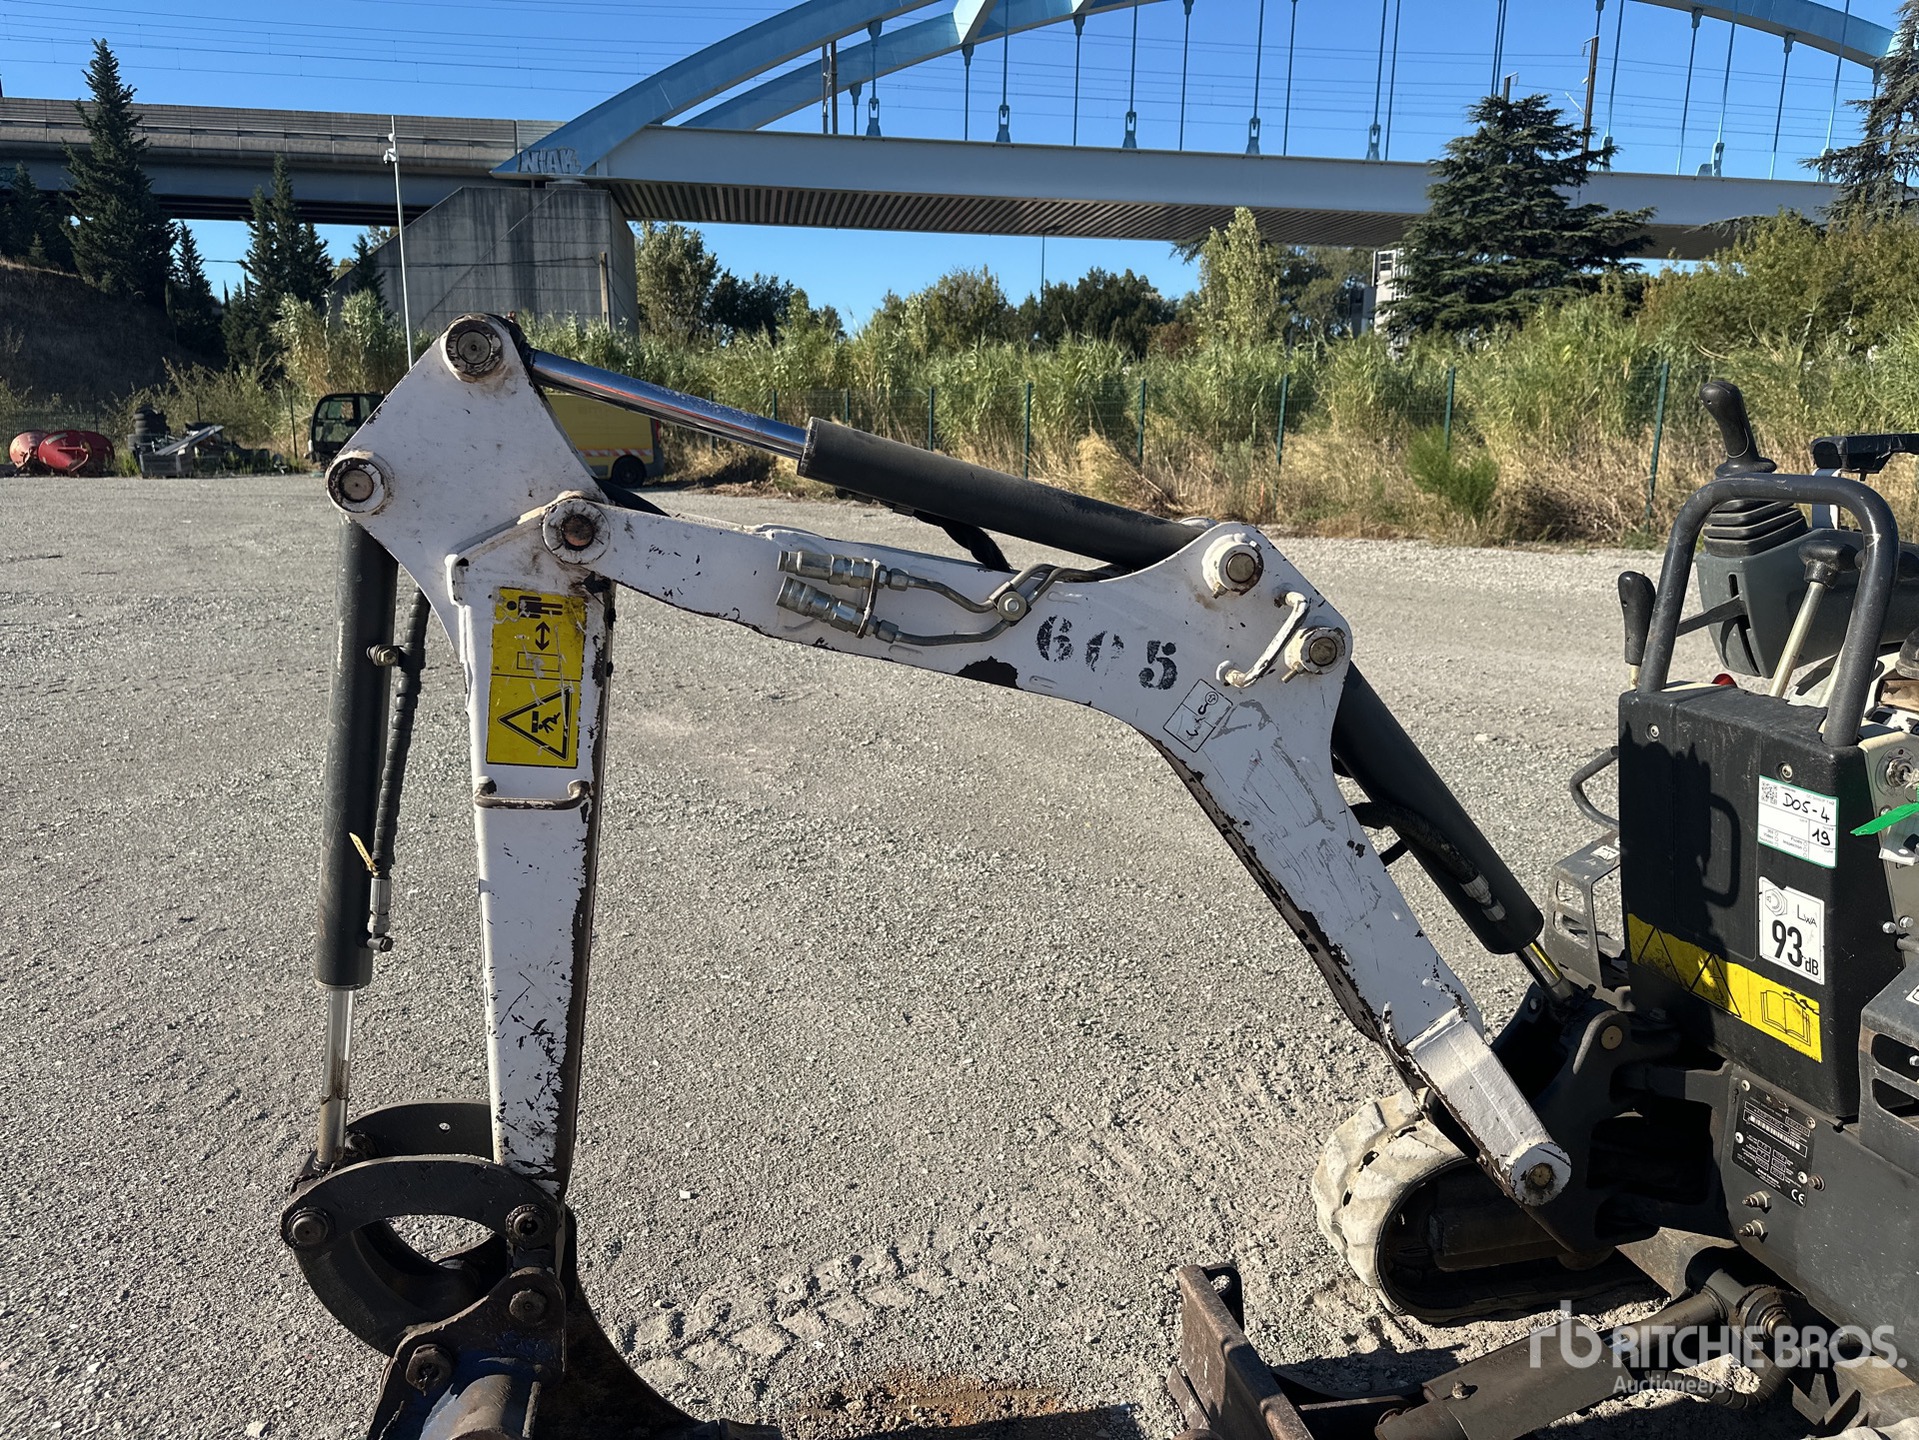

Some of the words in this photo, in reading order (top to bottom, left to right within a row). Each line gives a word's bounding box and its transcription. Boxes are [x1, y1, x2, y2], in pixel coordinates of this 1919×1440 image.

[1812, 828, 1831, 846] 19
[1772, 919, 1802, 967] 93
[1804, 957, 1819, 975] dB
